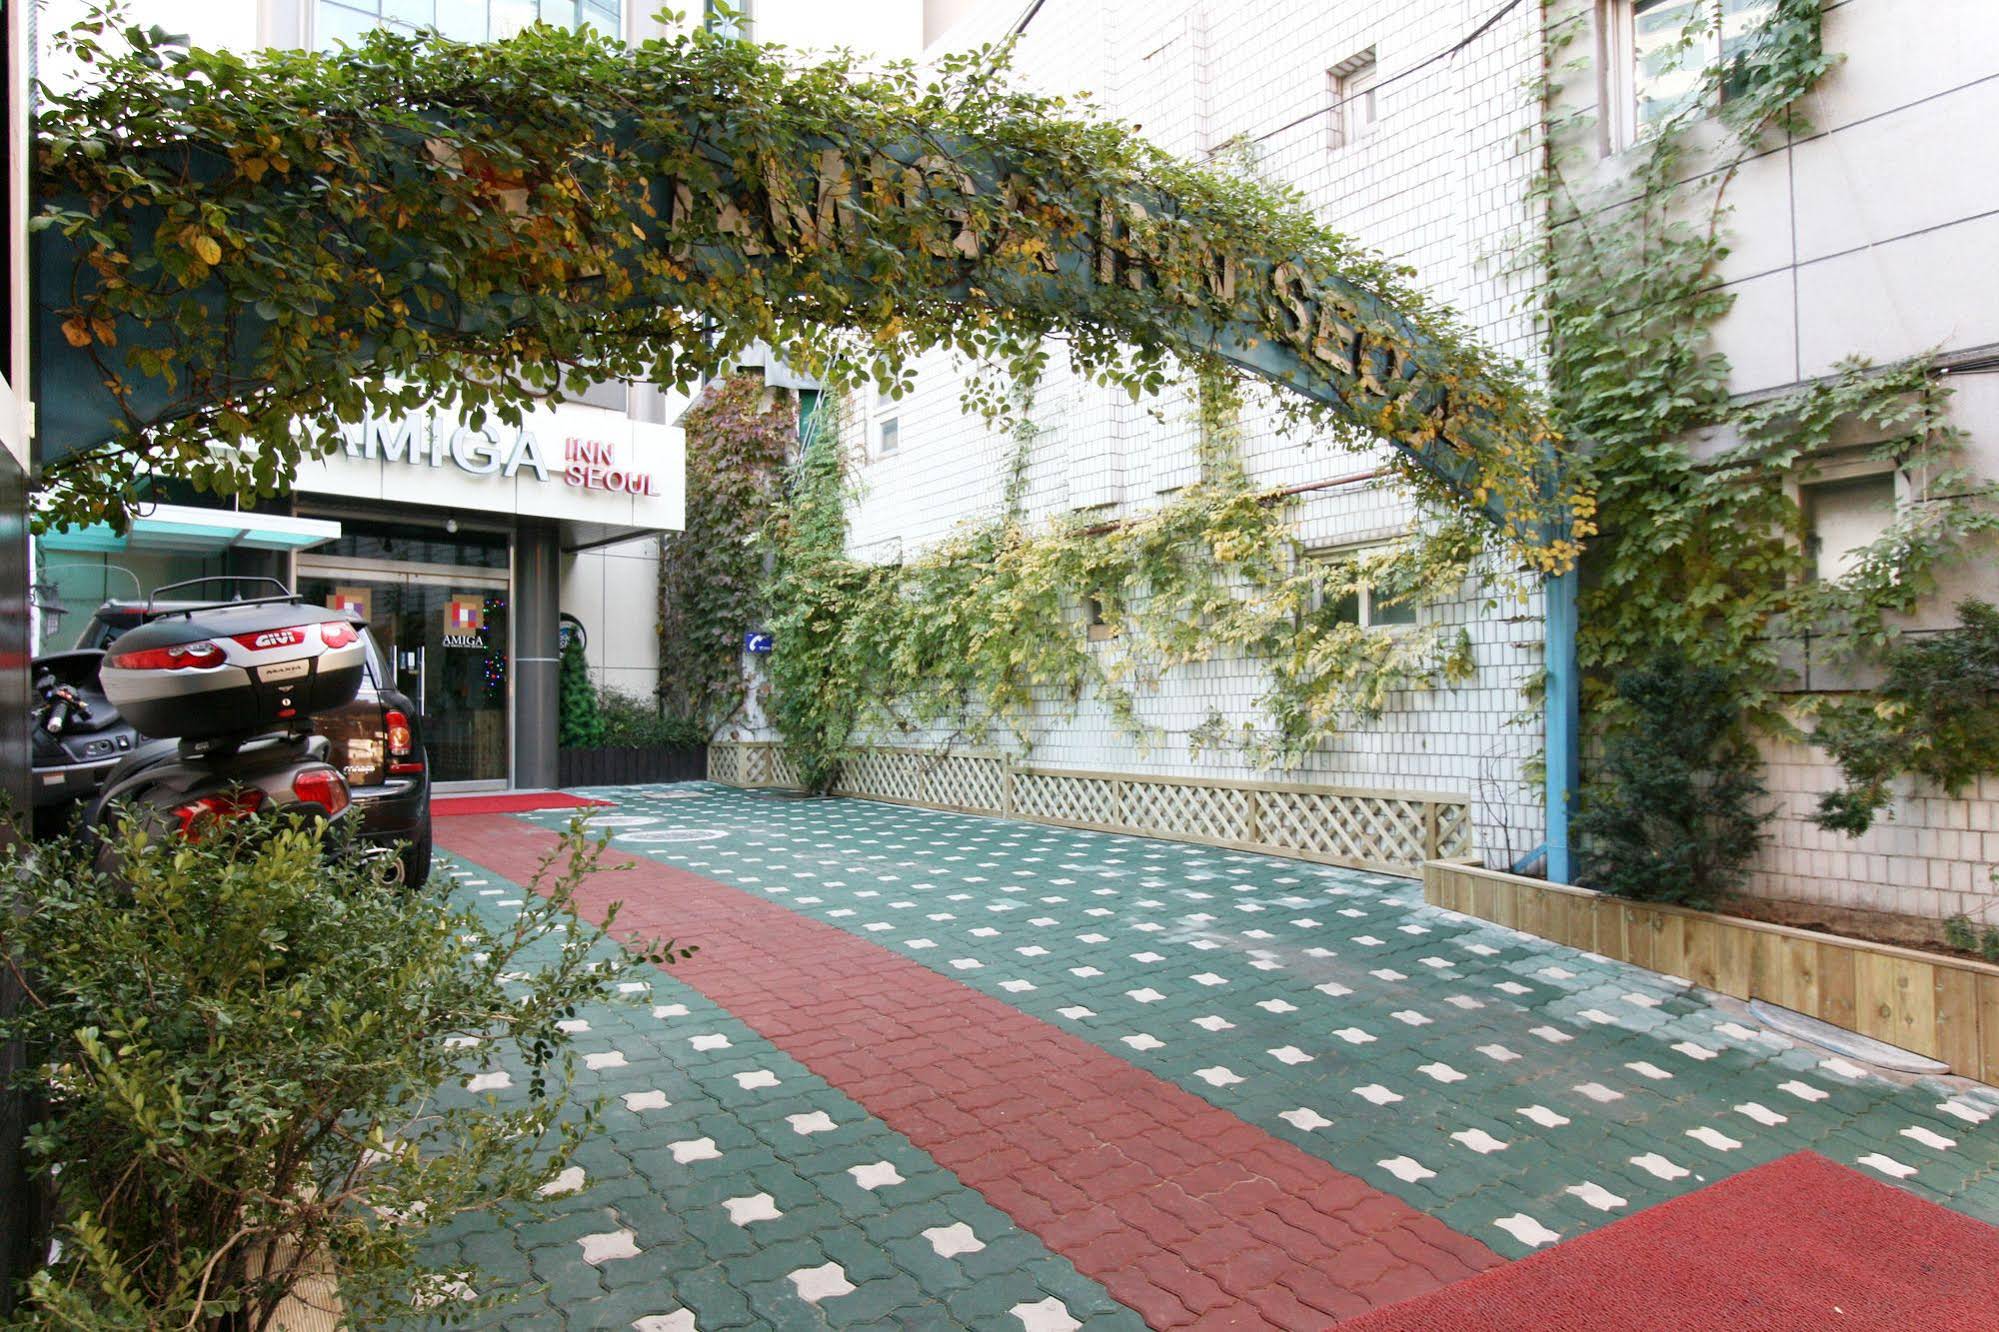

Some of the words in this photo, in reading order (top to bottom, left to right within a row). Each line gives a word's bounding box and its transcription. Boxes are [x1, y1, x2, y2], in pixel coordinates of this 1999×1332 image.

[565, 437, 615, 466] INN
[564, 464, 661, 497] SEOUL
[255, 631, 296, 648] GIVI
[442, 635, 483, 647] AMIGA
